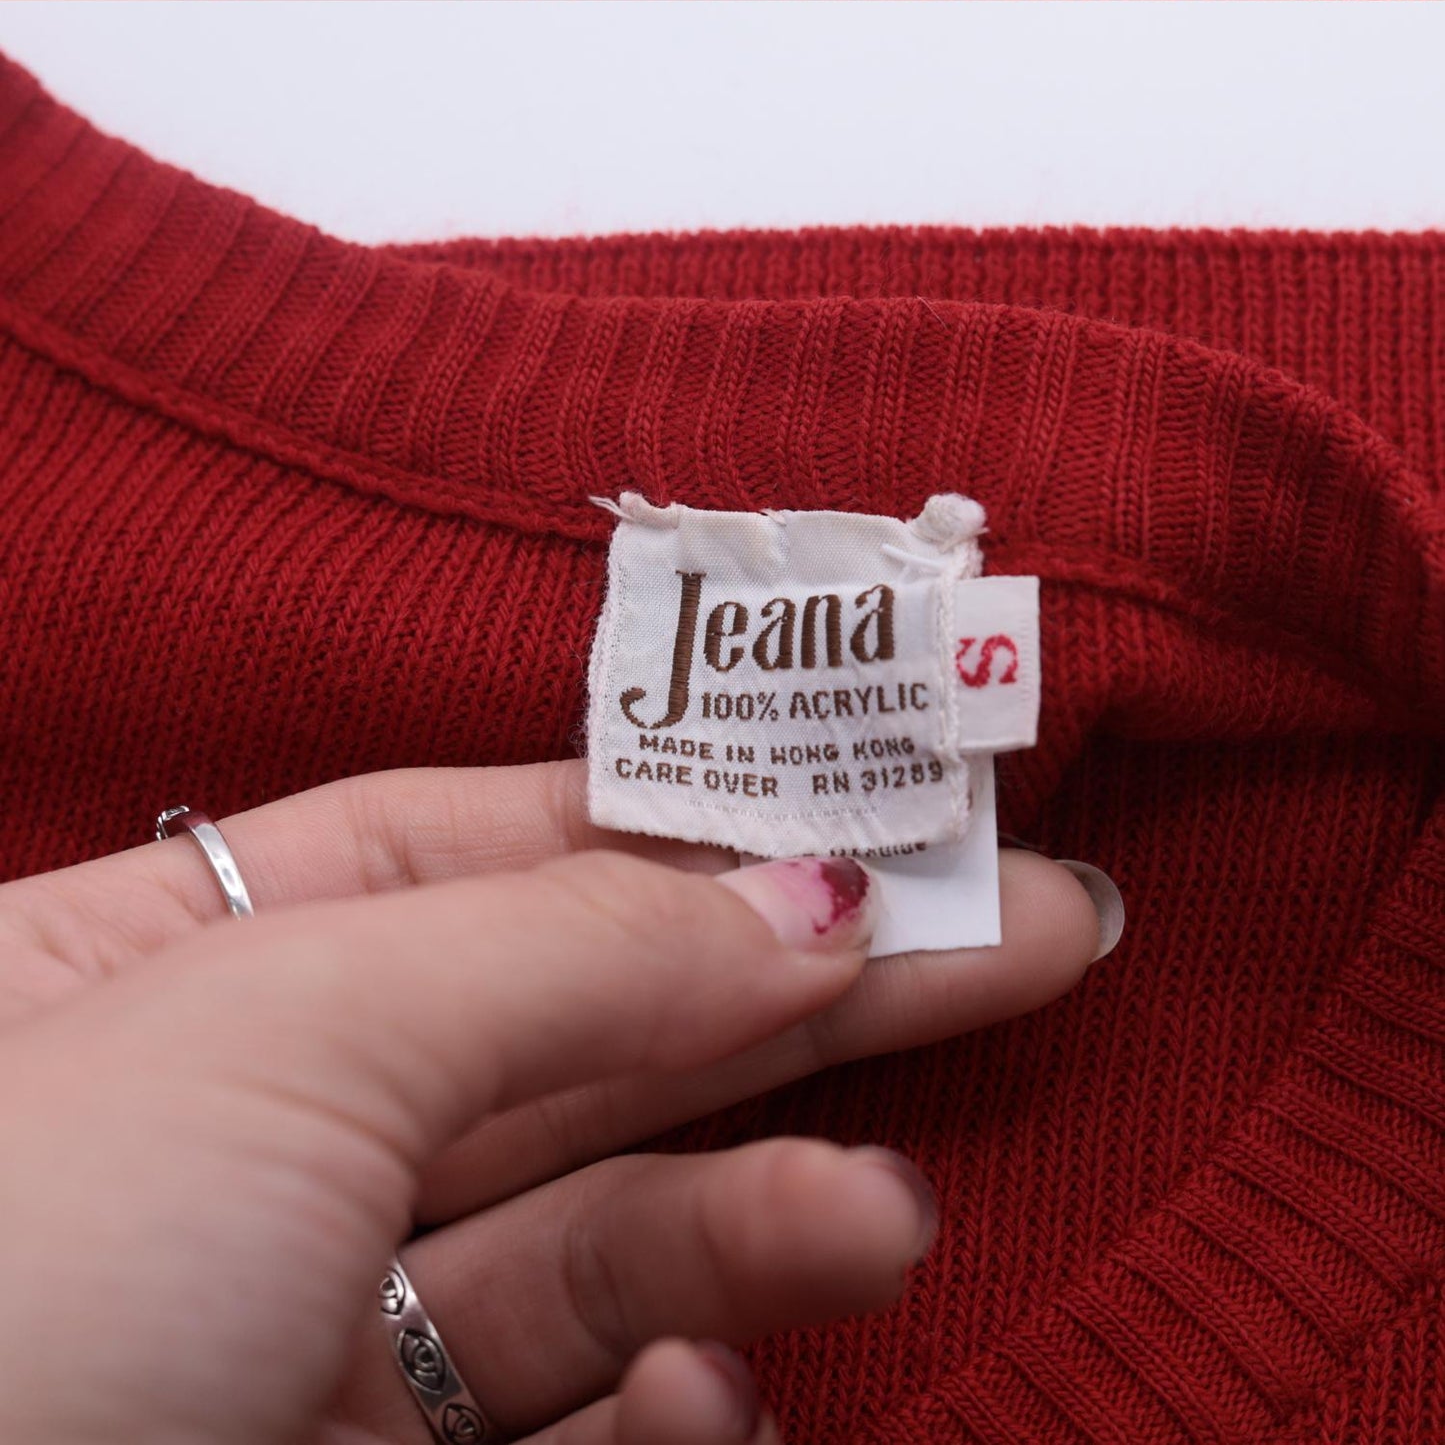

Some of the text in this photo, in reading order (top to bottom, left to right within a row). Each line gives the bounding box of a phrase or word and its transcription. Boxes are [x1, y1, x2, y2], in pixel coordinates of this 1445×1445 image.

[619, 569, 896, 730] Jeana
[956, 634, 1019, 689] S
[701, 682, 929, 722] 100% ACRYLIC
[639, 734, 916, 766] MADE IN HONG KONG
[615, 757, 944, 798] CARE OVER RN 31289
